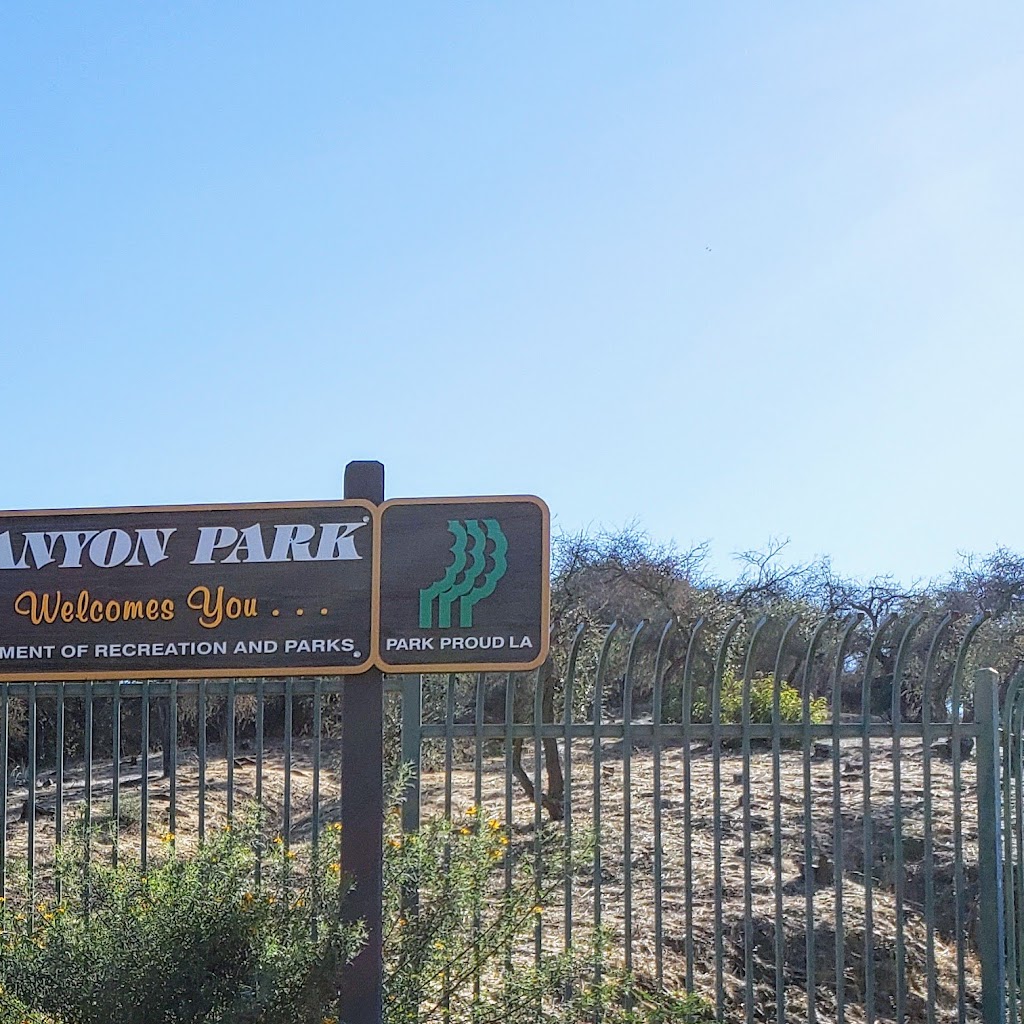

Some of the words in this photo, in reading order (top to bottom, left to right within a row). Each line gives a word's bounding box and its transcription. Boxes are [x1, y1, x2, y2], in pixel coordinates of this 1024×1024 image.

[189, 522, 369, 564] PARK
[14, 590, 174, 625] Welcomes
[187, 585, 258, 629] You
[61, 645, 88, 659] OF
[94, 641, 227, 658] RECREATION
[233, 639, 278, 654] AND
[284, 638, 354, 653] PARKS
[386, 638, 434, 651] PARK
[440, 636, 505, 650] PROUD
[510, 636, 533, 649] LA
